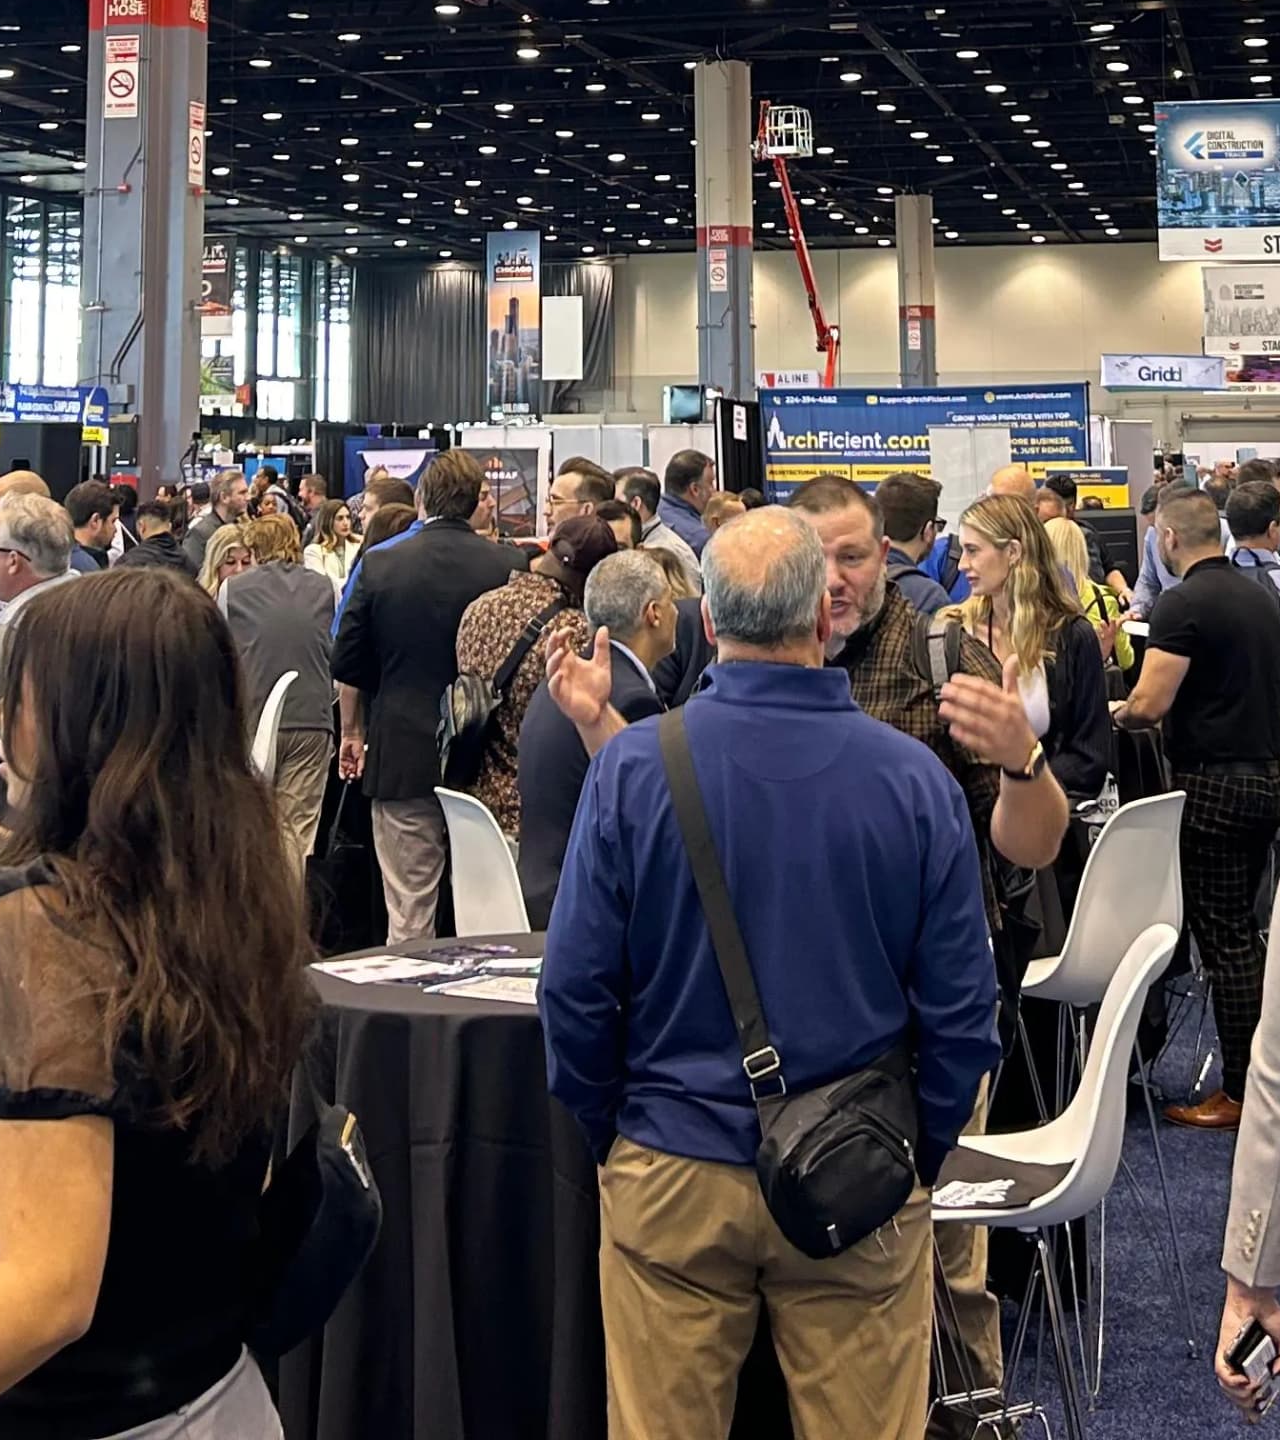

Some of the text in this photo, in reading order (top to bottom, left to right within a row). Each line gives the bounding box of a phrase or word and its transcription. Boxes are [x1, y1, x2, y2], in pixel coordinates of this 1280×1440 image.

[108, 3, 147, 16] HOSE
[1207, 131, 1235, 140] DIGITAL
[1207, 140, 1264, 150] CONSTRUCTION
[777, 373, 809, 384] ALINE
[768, 416, 930, 449] ArchFicient.com
